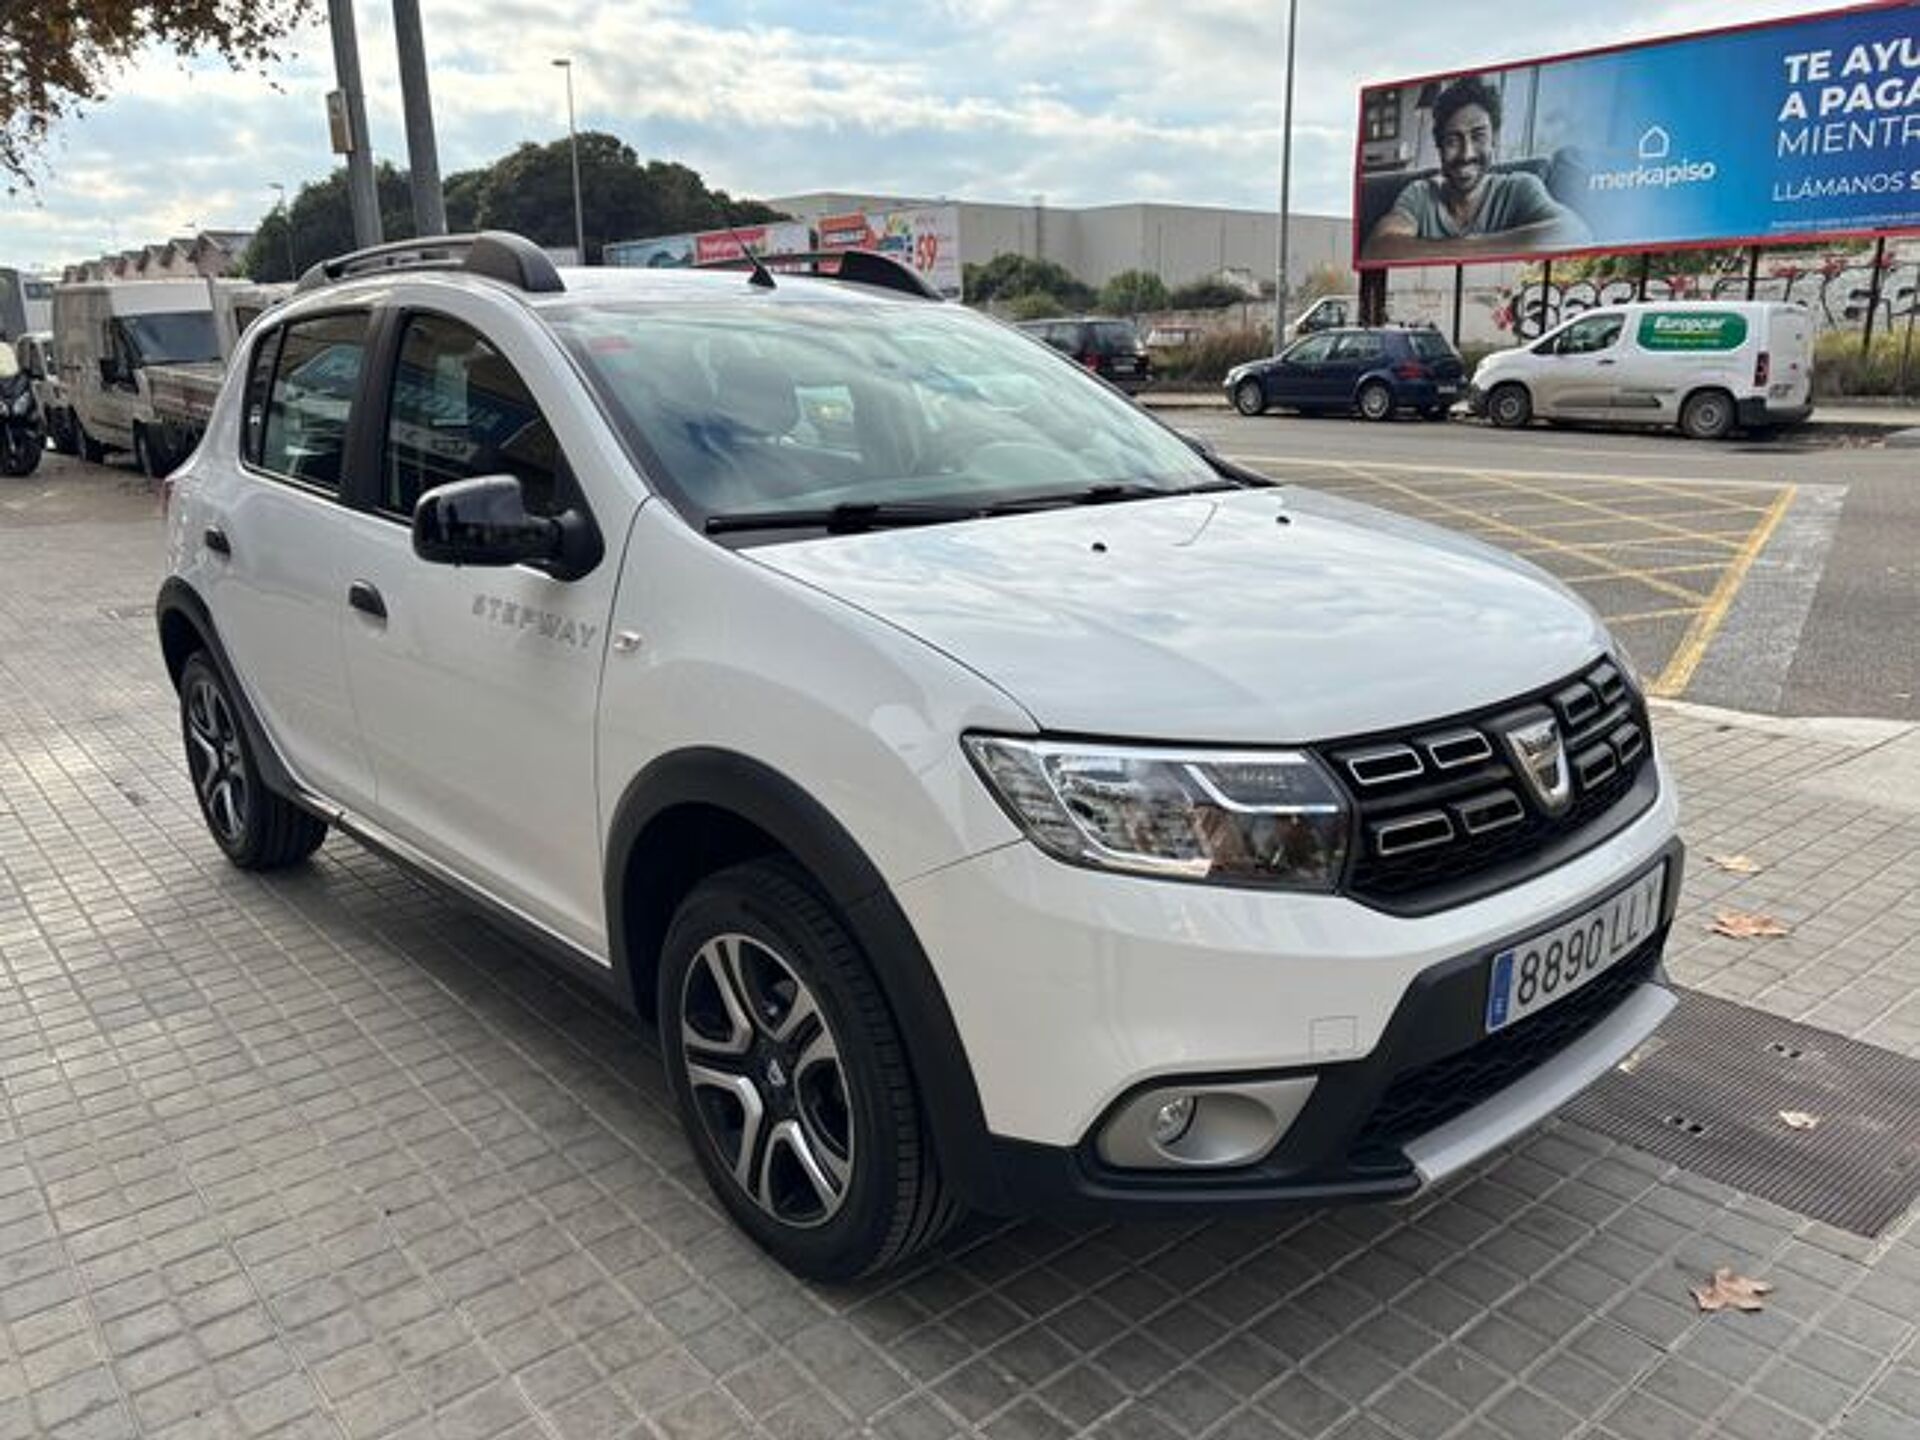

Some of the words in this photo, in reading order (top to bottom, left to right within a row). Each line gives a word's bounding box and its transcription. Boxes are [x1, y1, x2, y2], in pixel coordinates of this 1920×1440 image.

[1784, 50, 1831, 84] TE
[1841, 37, 1920, 78] AYU
[1778, 92, 1808, 122] A
[1589, 158, 1716, 190] merkapiso
[1773, 171, 1905, 202] LLÁMANOS
[472, 594, 598, 648] STEPWAY
[1517, 918, 1605, 1006] 8890
